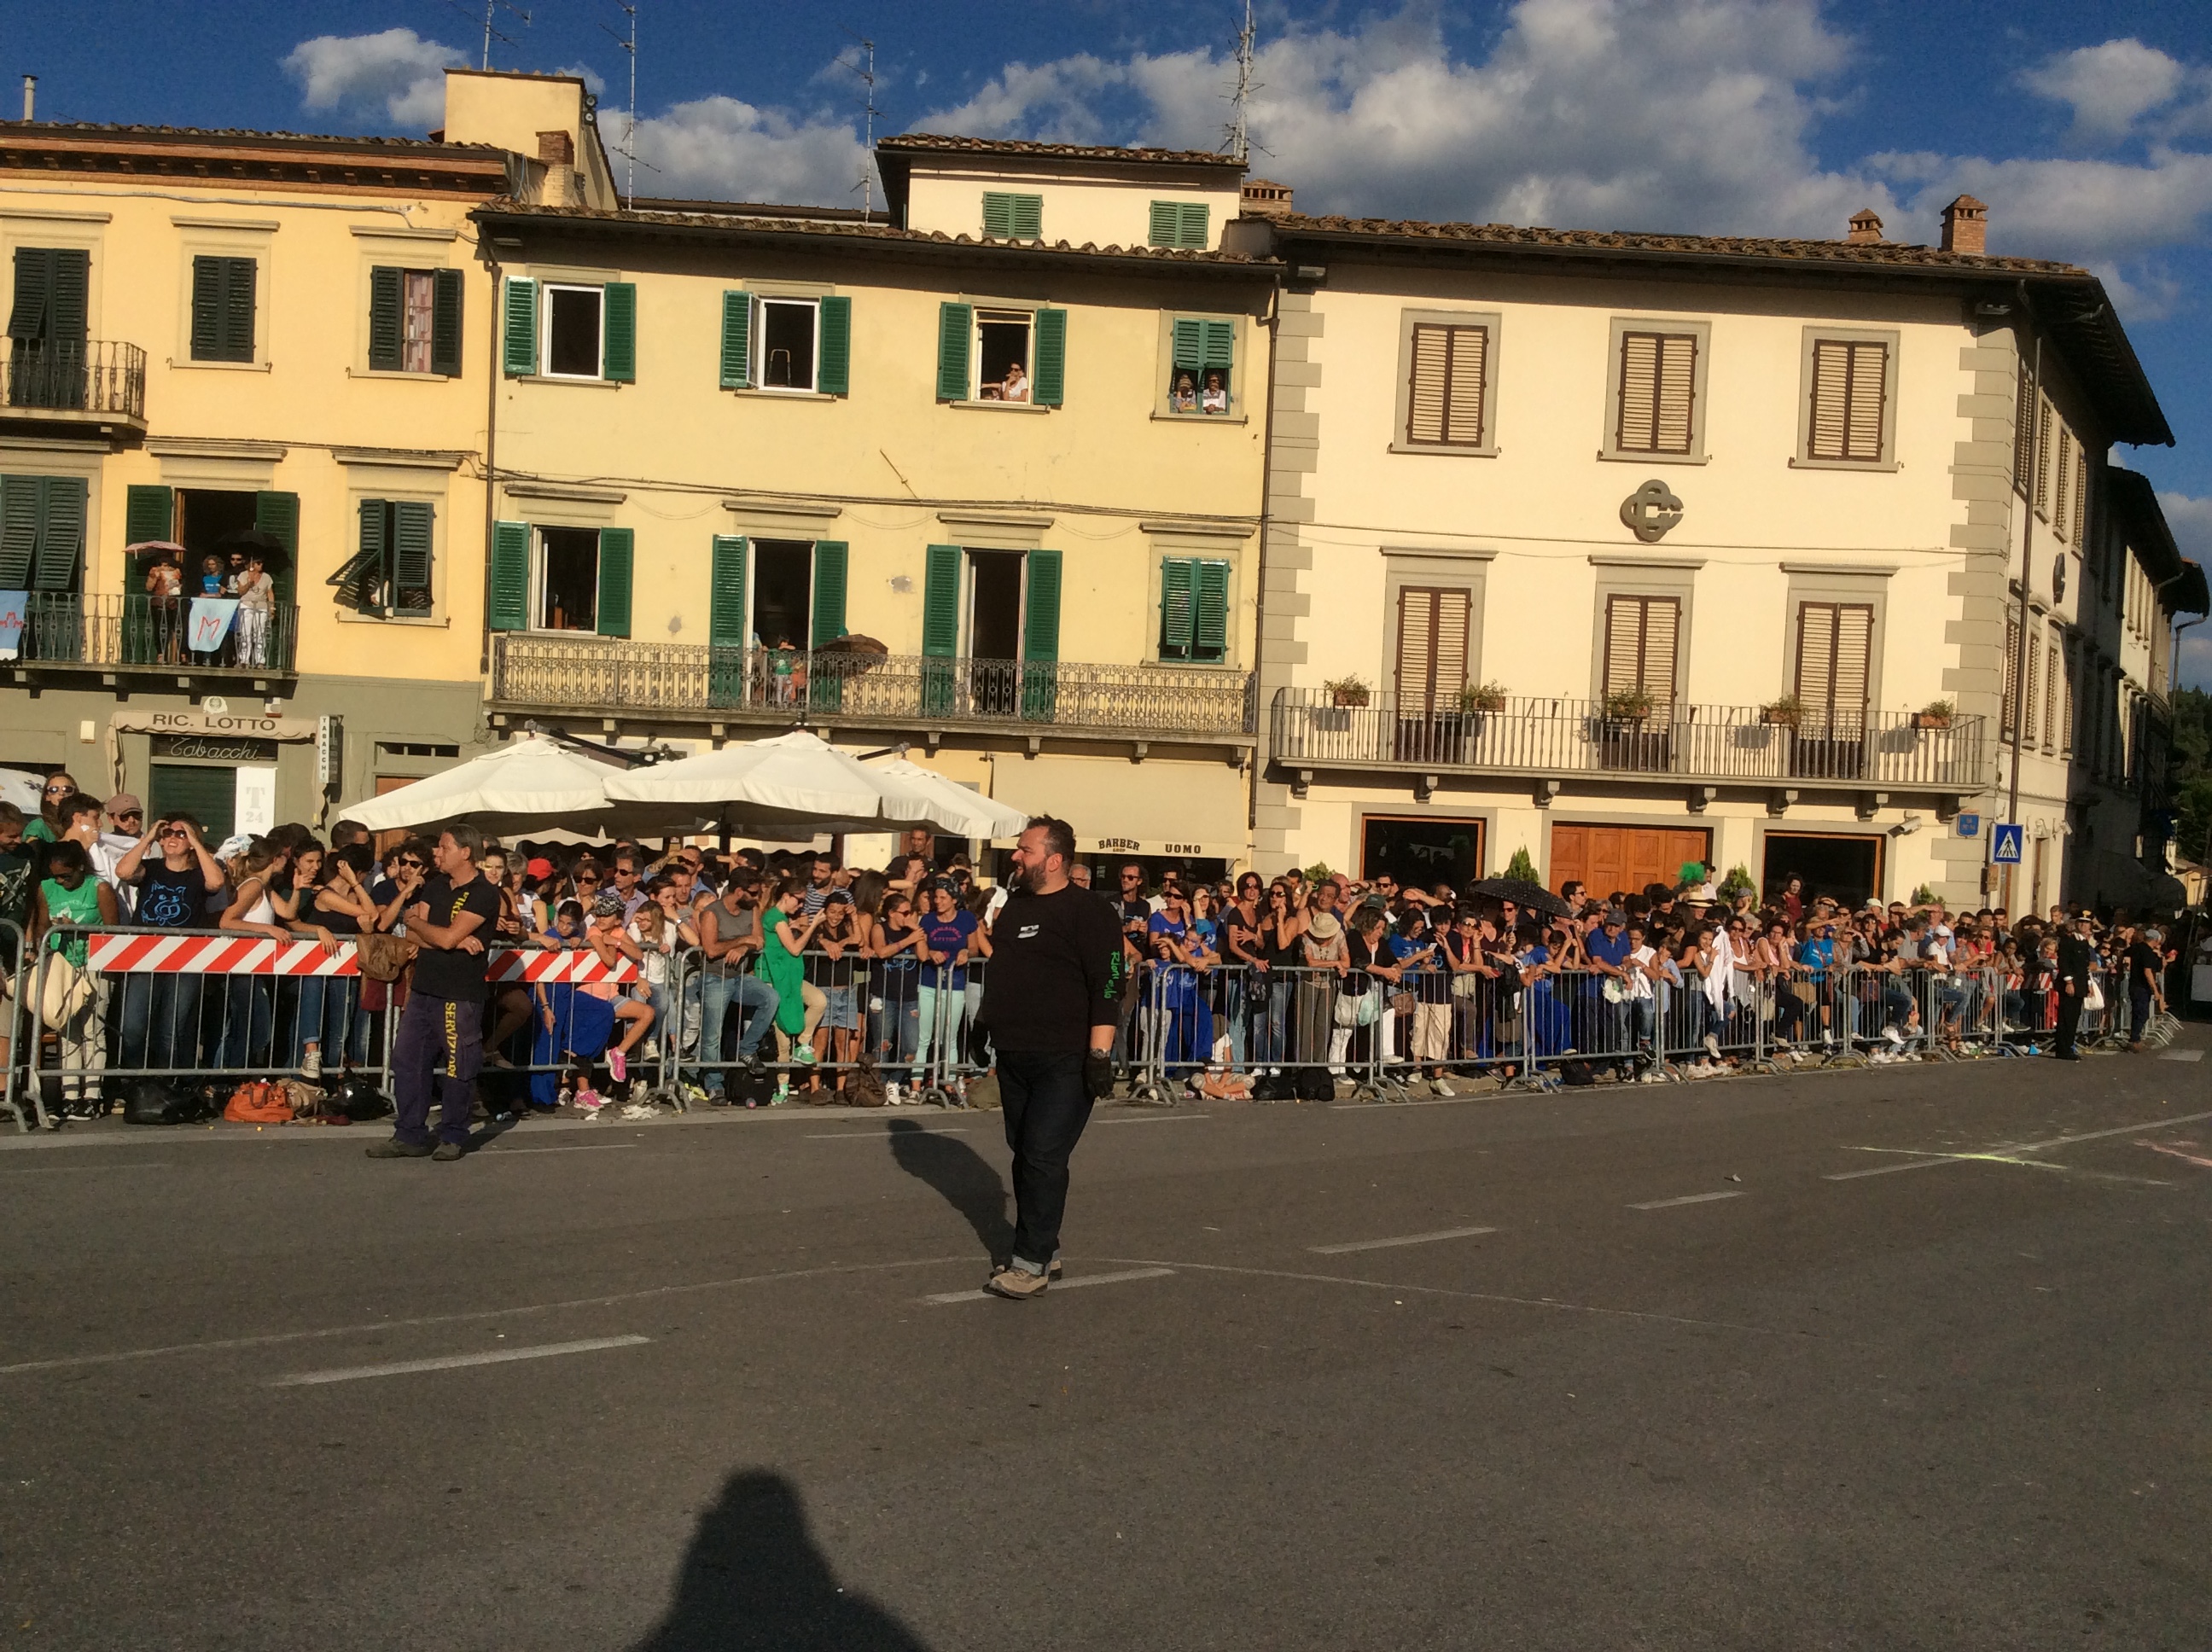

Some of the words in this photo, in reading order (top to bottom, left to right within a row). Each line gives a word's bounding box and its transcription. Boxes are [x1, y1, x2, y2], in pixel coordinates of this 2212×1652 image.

[197, 616, 220, 641] M
[152, 713, 195, 727] RIC.
[205, 717, 276, 731] LOTTO
[170, 736, 260, 760] Tabacchi
[246, 787, 265, 809] T
[246, 811, 264, 823] 24
[1097, 838, 1140, 852] BARBER
[1165, 844, 1202, 854] UOMO
